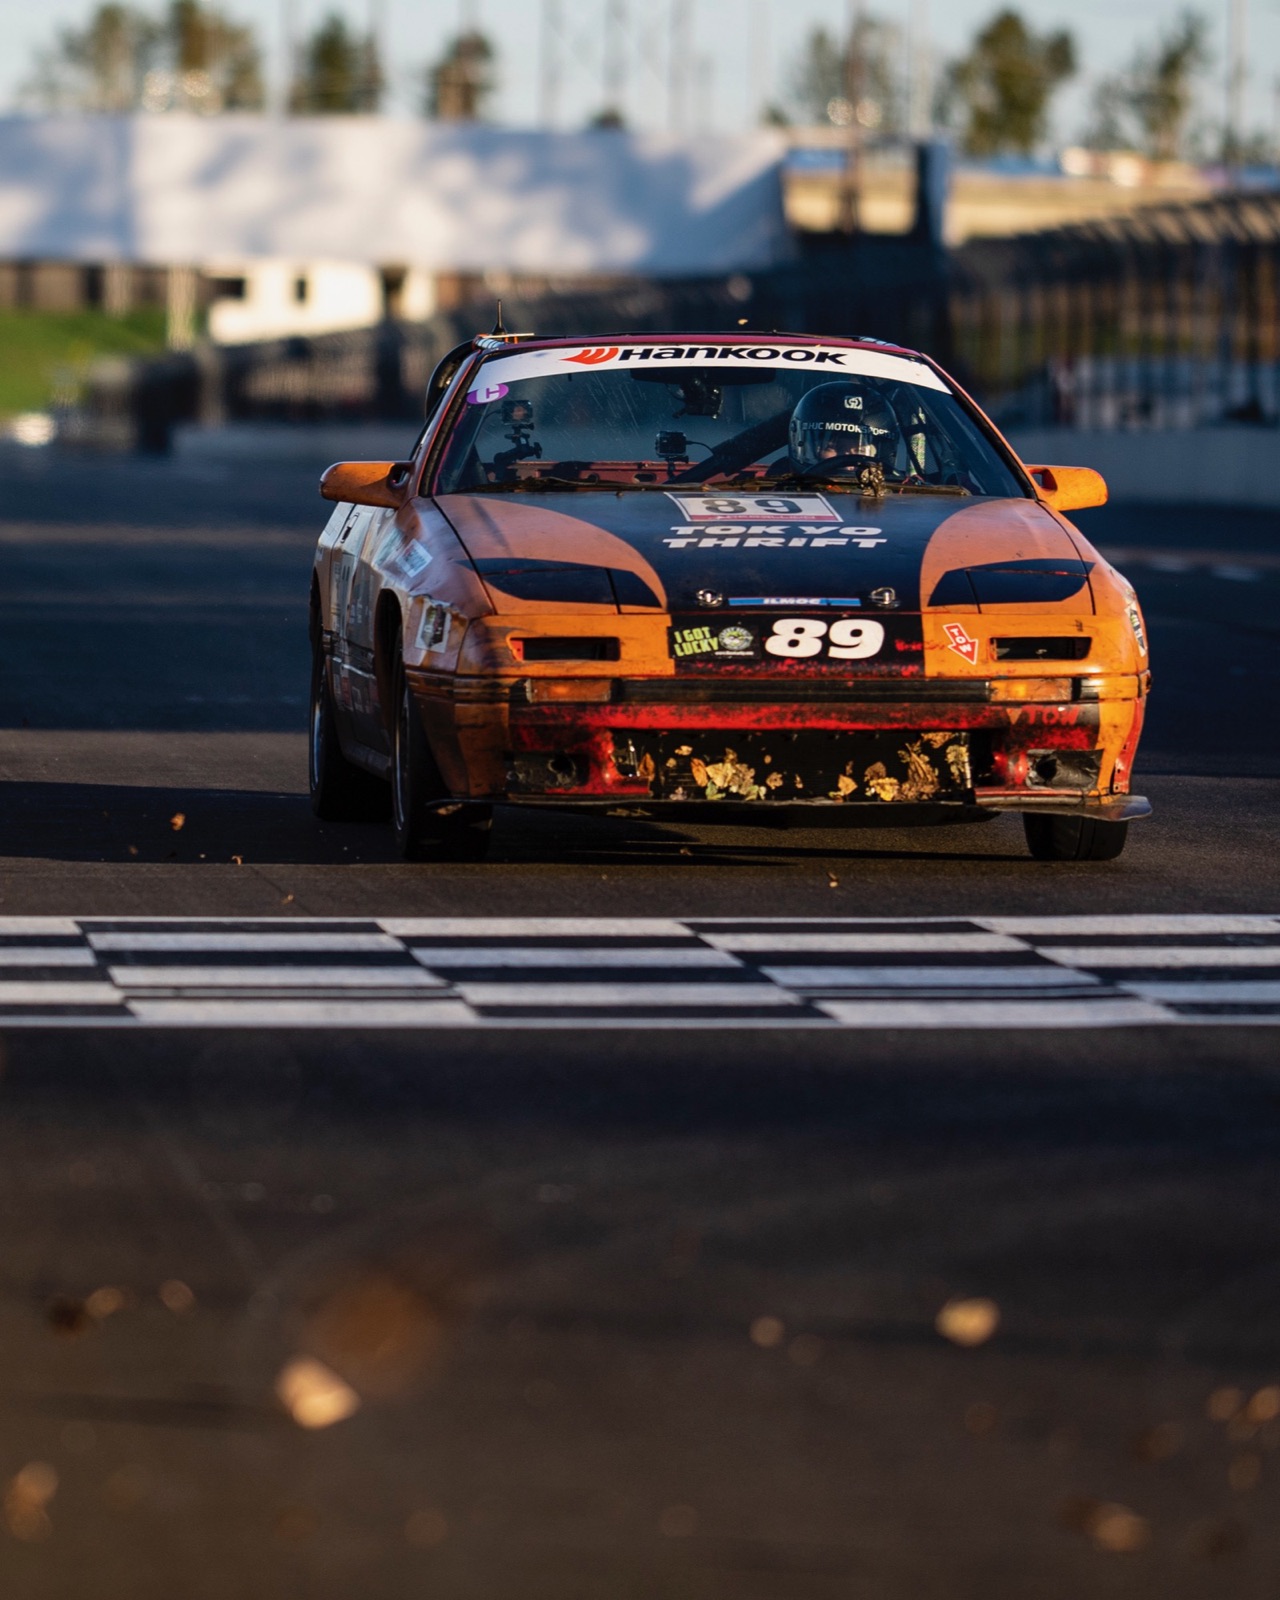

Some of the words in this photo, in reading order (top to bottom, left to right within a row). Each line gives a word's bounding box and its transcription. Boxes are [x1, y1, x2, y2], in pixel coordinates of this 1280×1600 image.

[701, 499, 803, 514] 89
[670, 525, 882, 536] TOKYO
[662, 537, 888, 549] THRIFT
[674, 631, 682, 644] I
[682, 626, 711, 642] GOT
[764, 618, 885, 660] 89
[949, 627, 973, 654] TOW
[674, 637, 719, 657] LUCKY
[1021, 705, 1080, 726] TOW
